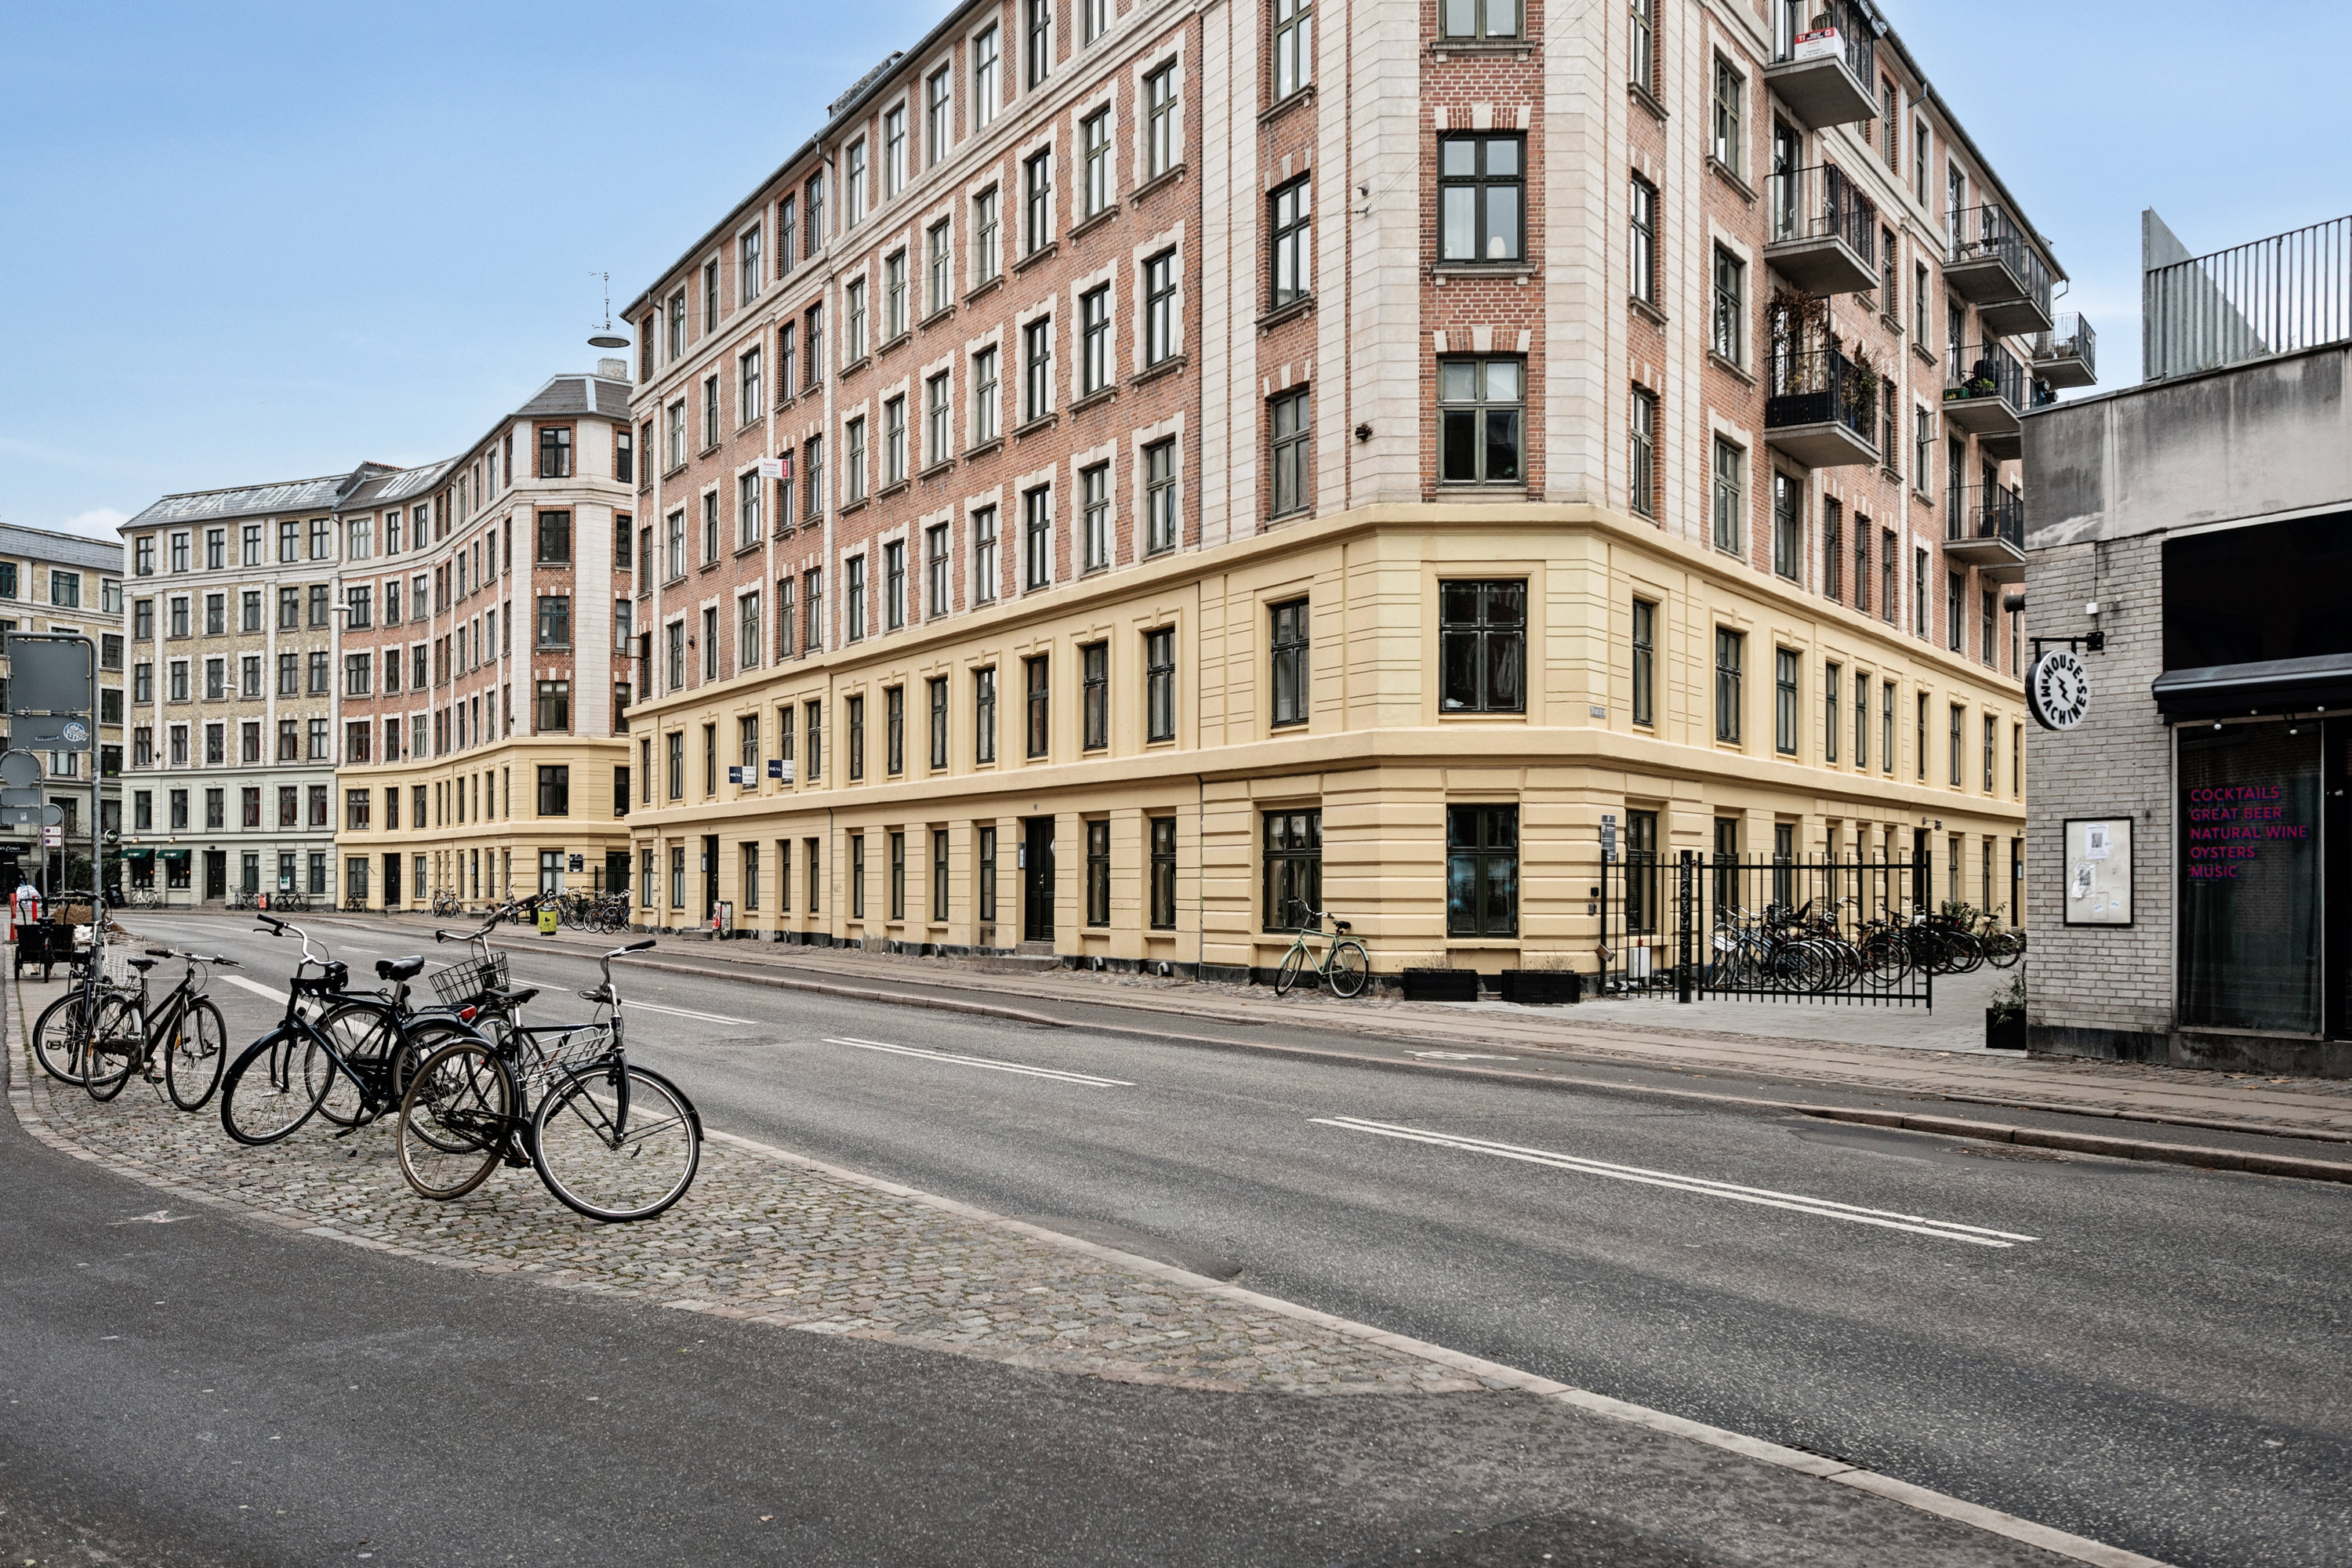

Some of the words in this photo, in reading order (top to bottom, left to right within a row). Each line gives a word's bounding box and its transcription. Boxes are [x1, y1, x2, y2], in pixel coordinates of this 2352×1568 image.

[374, 467, 437, 499] OUT
[2043, 655, 2083, 679] HOUSE
[2041, 685, 2087, 724] MACHINES
[2190, 786, 2280, 801] COCKTAILS
[2190, 808, 2239, 821] GREAT
[2244, 807, 2282, 819] BEER
[2190, 826, 2262, 840] NATURAL
[2266, 825, 2308, 838] WINE
[2190, 846, 2256, 858] OYSTERS
[2190, 865, 2238, 877] MUSIC
